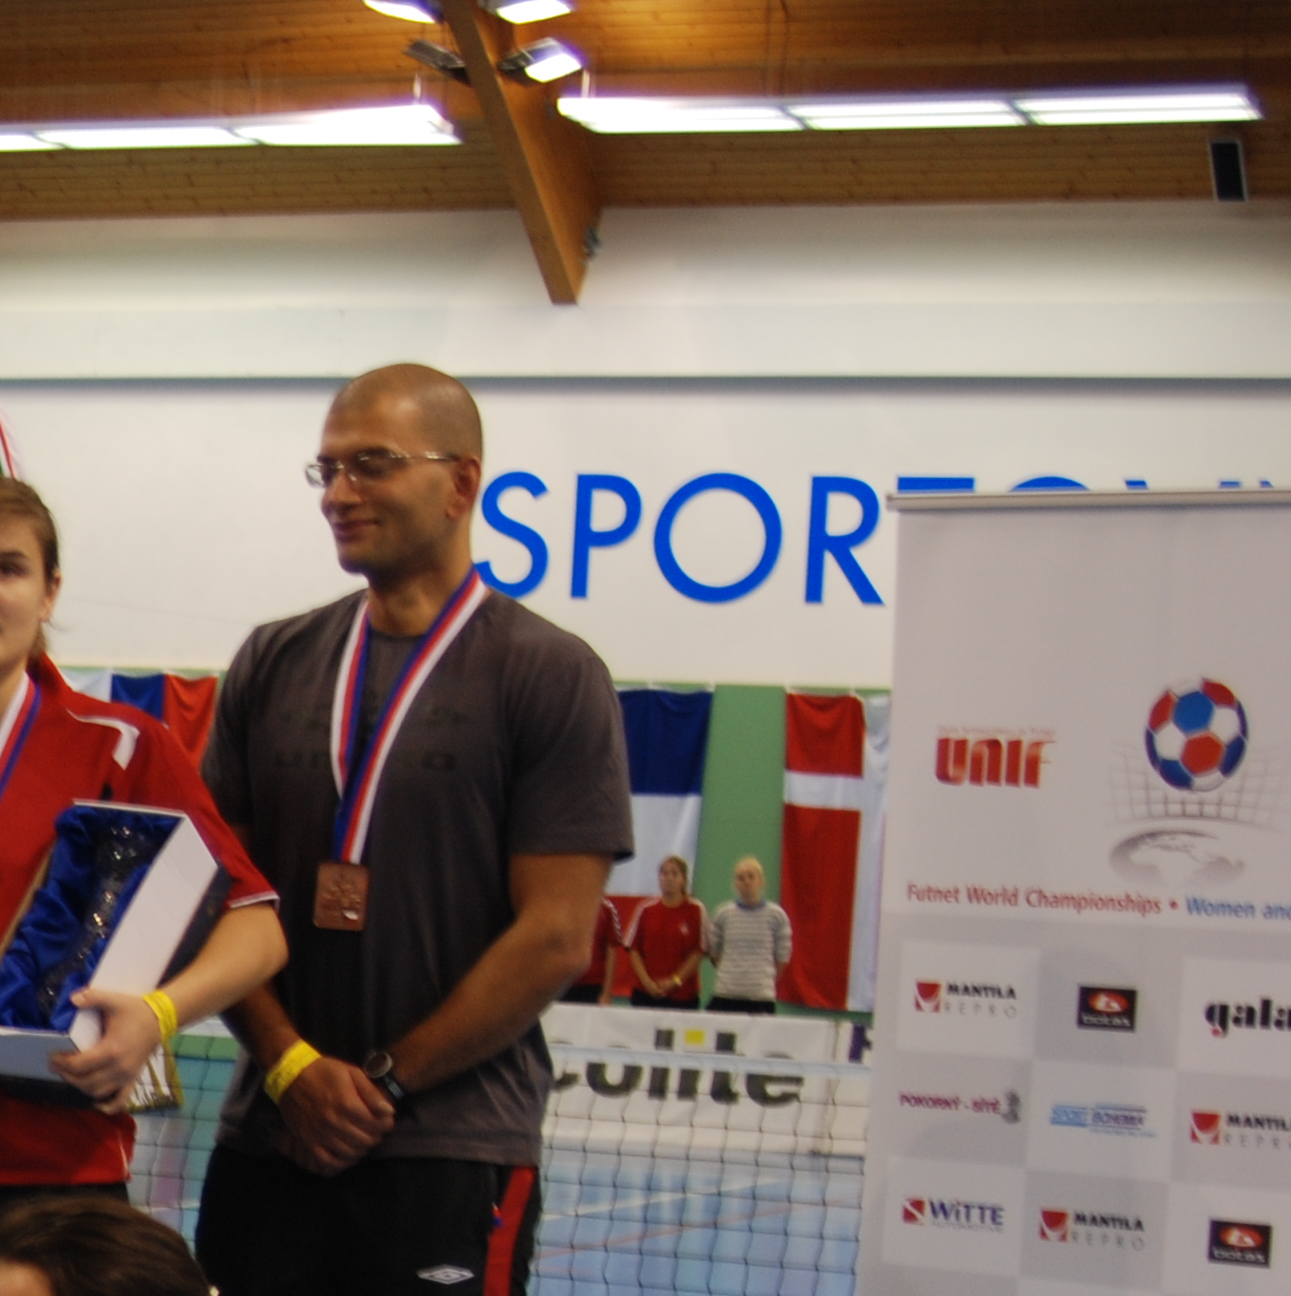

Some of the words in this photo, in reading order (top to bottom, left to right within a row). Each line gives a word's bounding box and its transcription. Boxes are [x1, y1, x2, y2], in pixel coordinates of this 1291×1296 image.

[907, 882, 960, 905] Futnet
[966, 885, 1018, 907] World
[1025, 890, 1161, 919] Championships
[1185, 895, 1256, 919] Women
[946, 982, 1017, 1000] MANTILA
[1226, 1114, 1291, 1133] MANTIL
[1224, 1133, 1291, 1150] REPR
[1073, 1212, 1145, 1233] MANTILA
